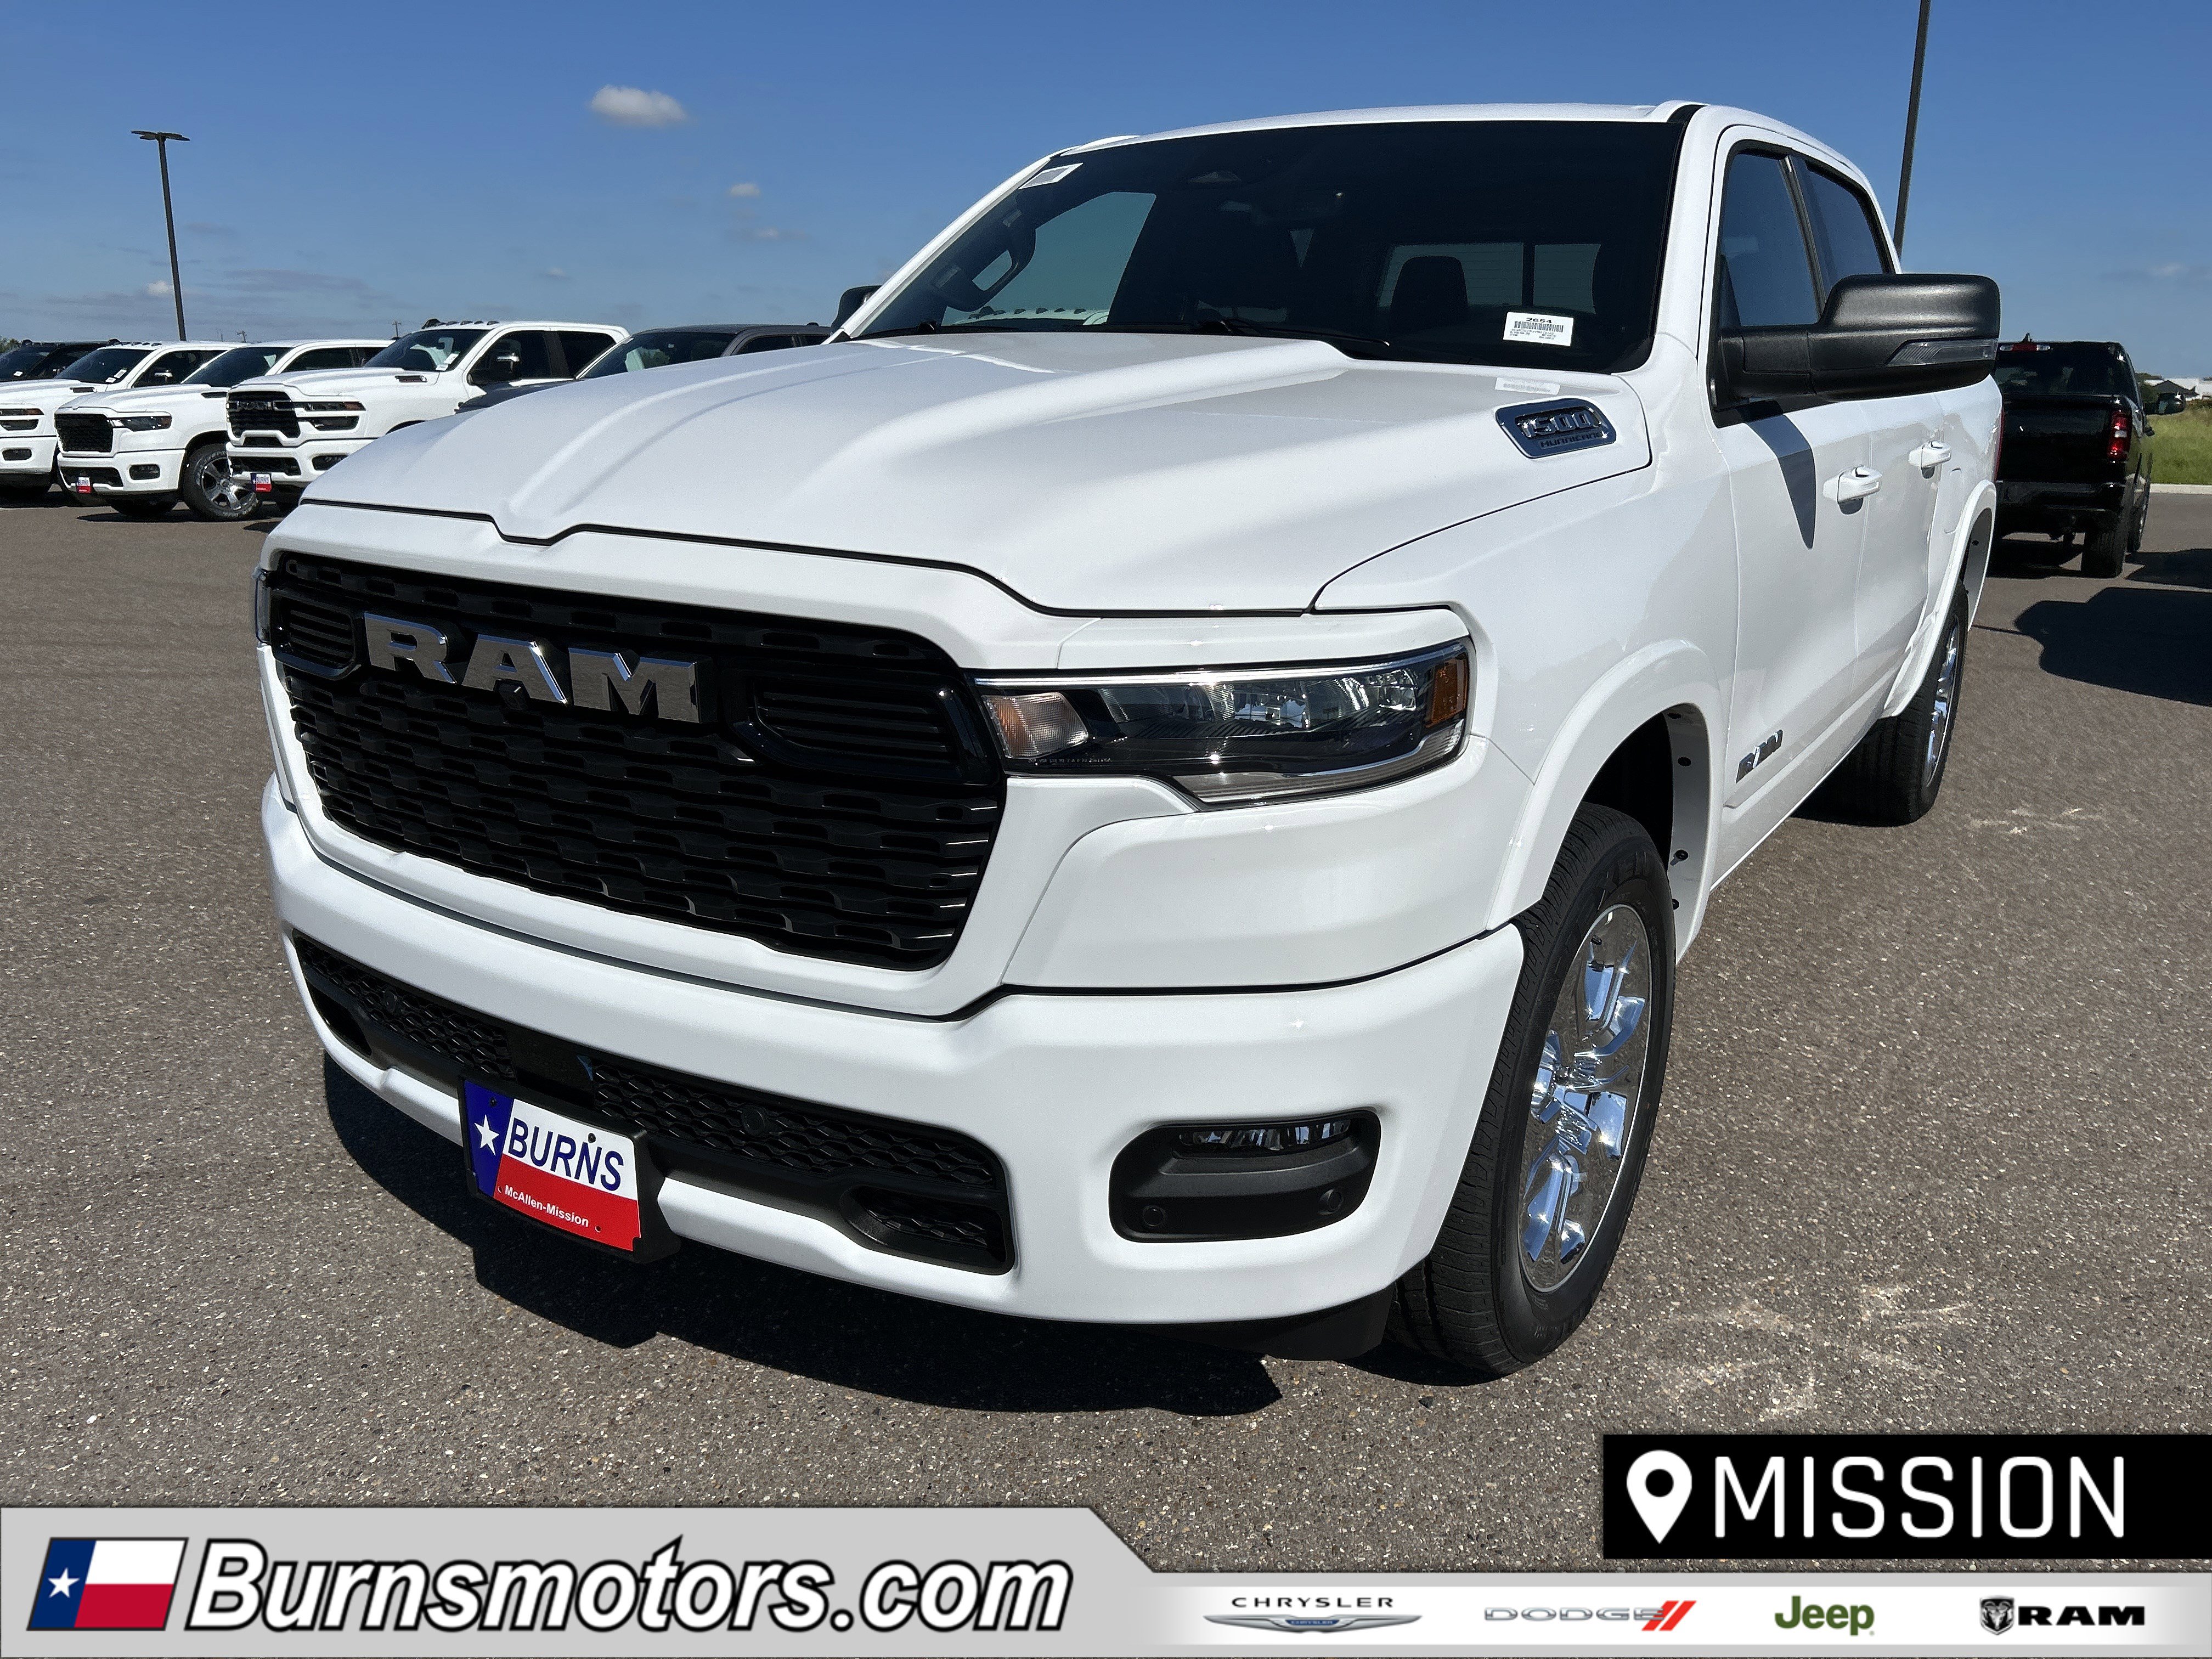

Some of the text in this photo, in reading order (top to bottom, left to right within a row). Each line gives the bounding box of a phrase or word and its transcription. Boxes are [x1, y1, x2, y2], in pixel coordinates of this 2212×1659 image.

[1522, 410, 1594, 438] 1500
[363, 611, 702, 724] RAM
[508, 1118, 624, 1191] BURNS
[504, 1184, 589, 1228] McAllen-Mission
